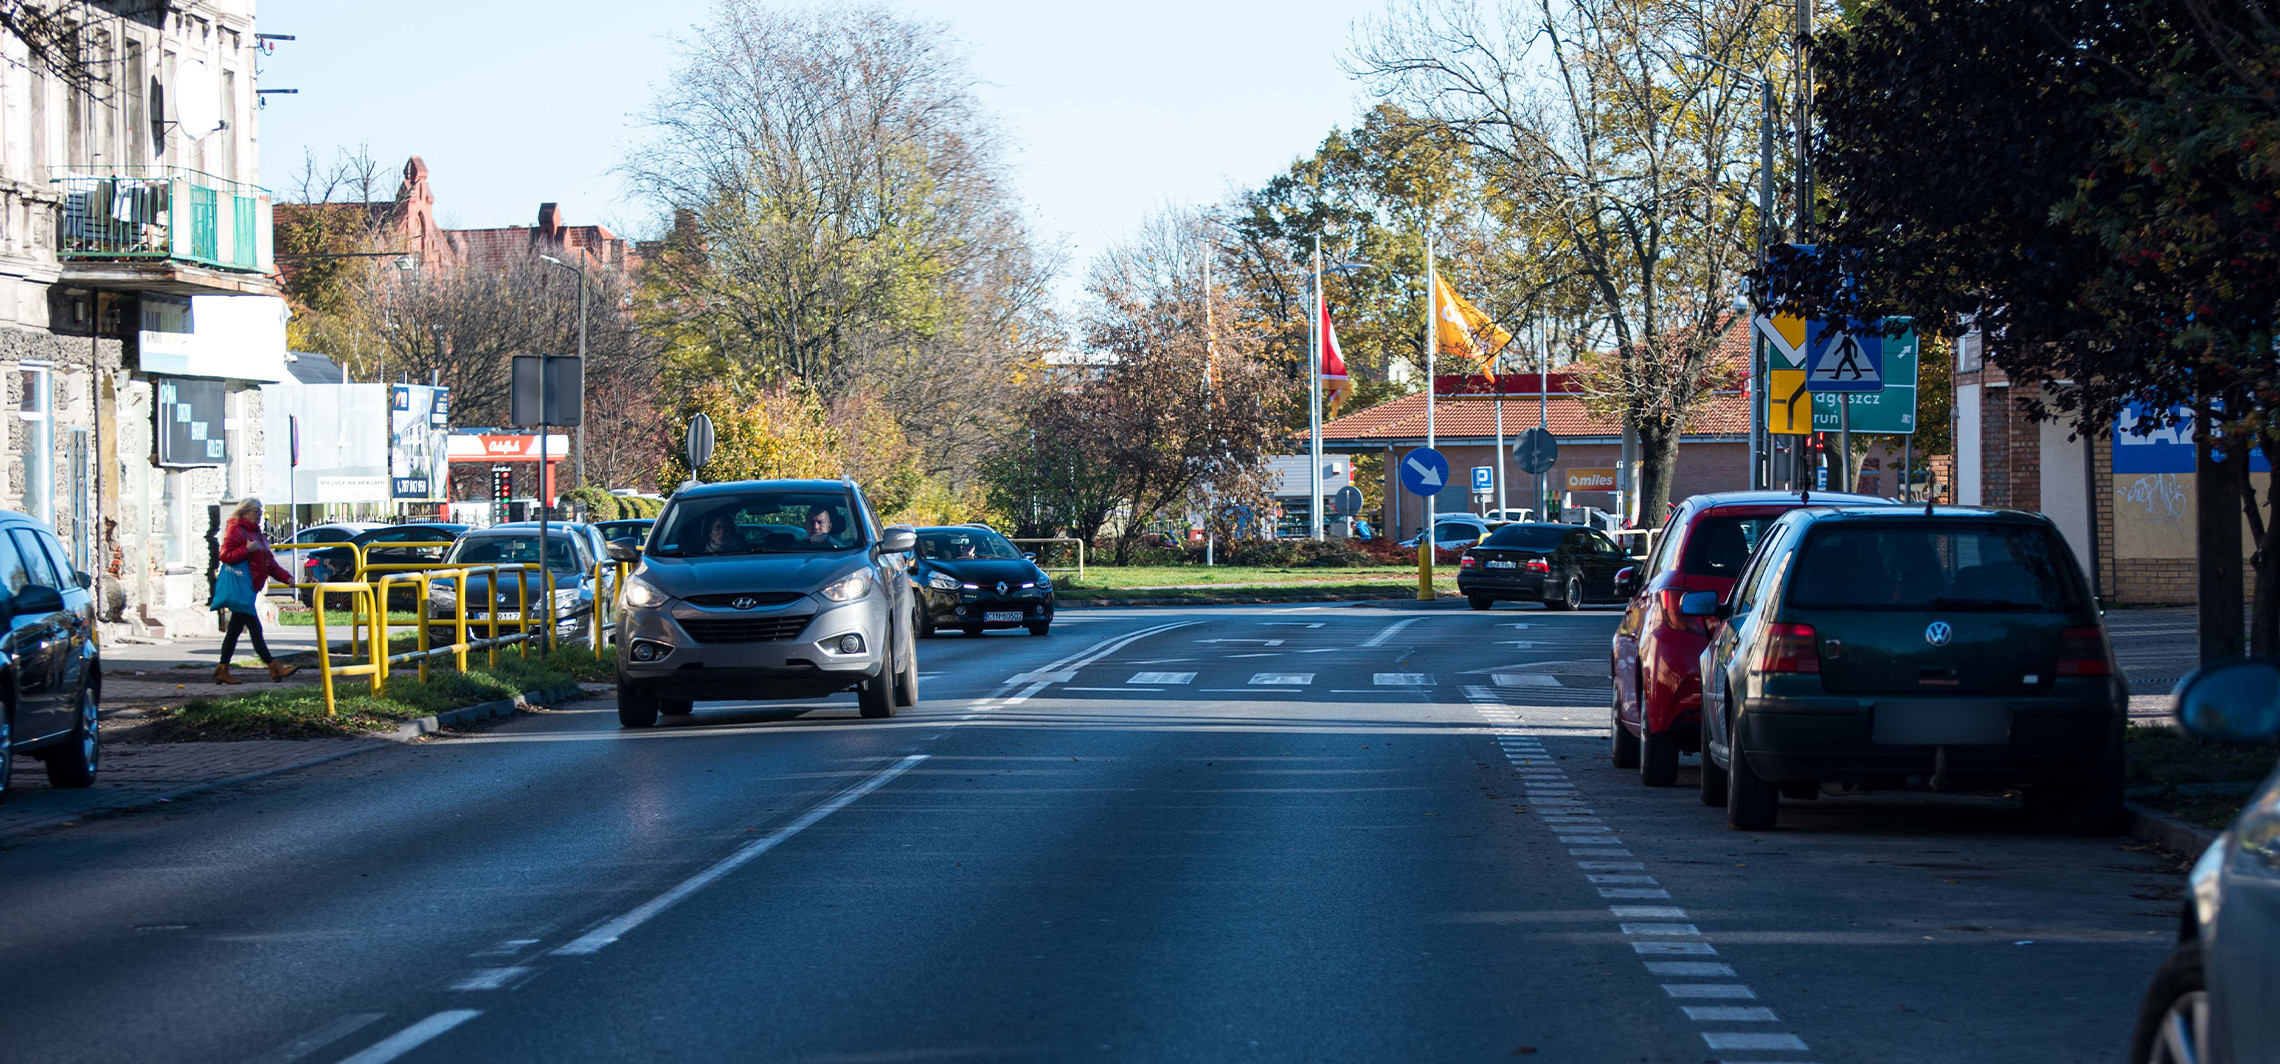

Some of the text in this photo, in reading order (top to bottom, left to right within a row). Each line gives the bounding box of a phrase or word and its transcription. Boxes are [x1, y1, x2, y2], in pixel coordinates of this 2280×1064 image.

[1813, 393, 1880, 407] dgszcz
[1814, 411, 1839, 424] ruń
[206, 439, 224, 457] ROLETY
[1579, 474, 1614, 486] miles
